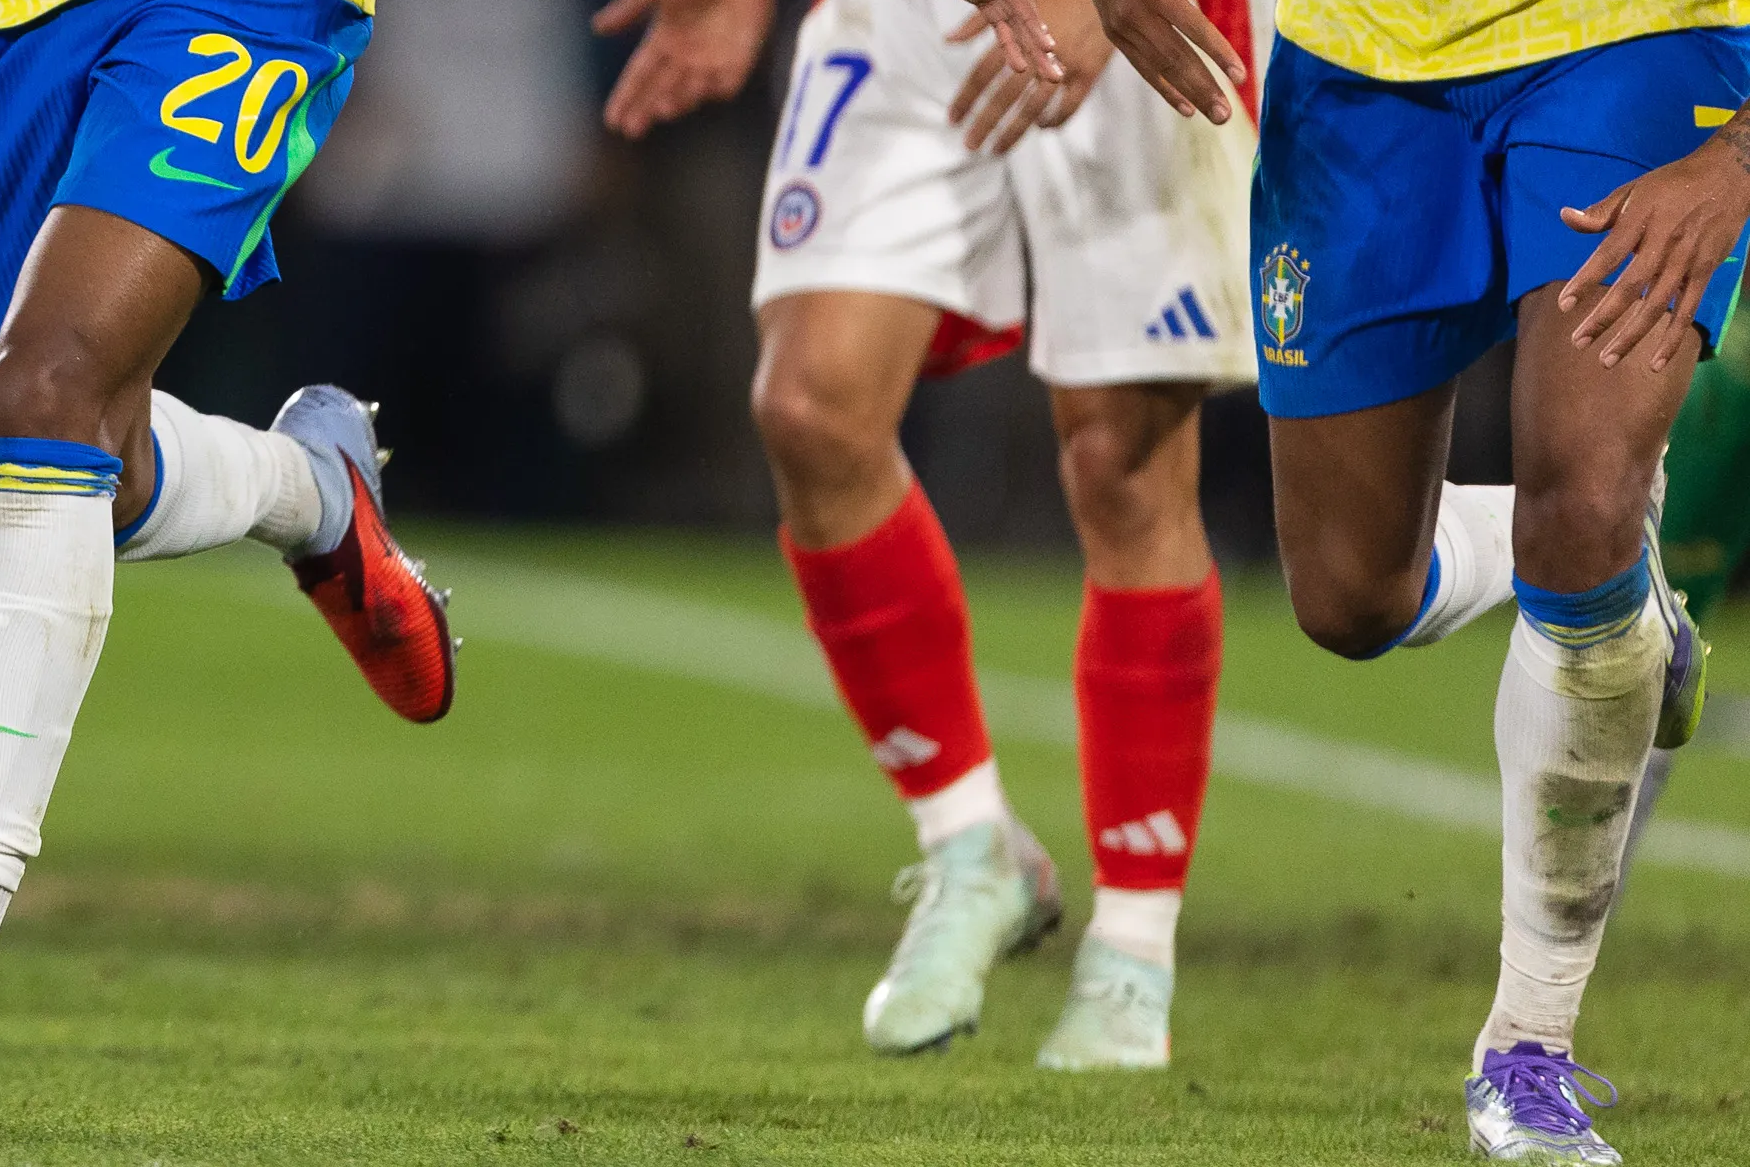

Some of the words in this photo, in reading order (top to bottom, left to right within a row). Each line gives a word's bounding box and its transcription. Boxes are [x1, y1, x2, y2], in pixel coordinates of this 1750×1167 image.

[160, 33, 308, 174] 20
[780, 52, 874, 171] 17
[1264, 345, 1308, 365] BRASIL
